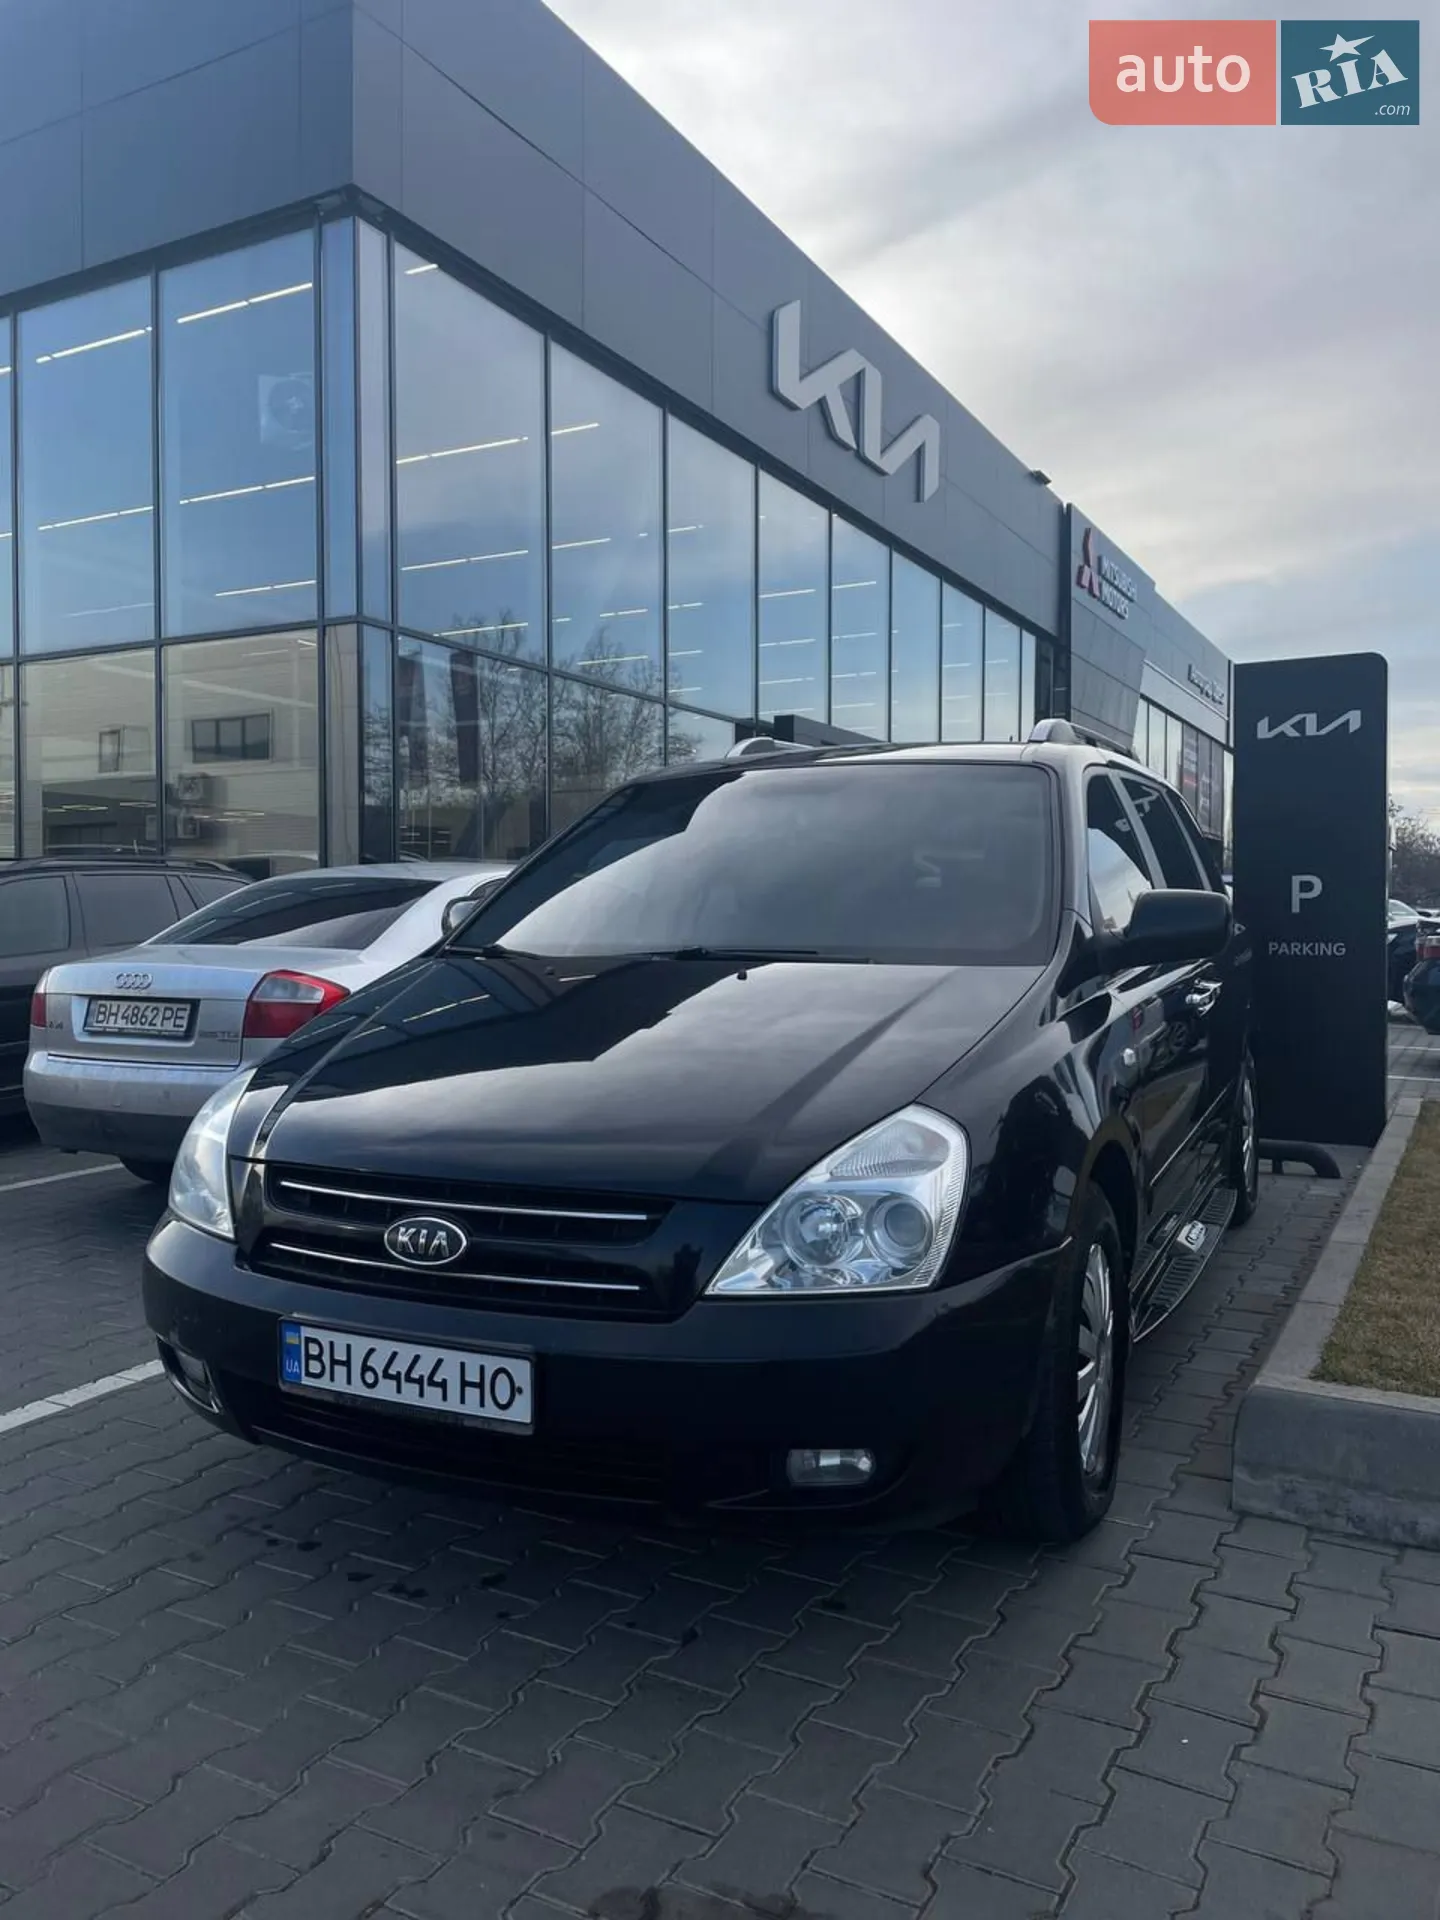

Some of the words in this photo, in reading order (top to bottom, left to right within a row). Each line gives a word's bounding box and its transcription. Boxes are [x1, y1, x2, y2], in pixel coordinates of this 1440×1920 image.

[1291, 875, 1323, 913] P
[1268, 942, 1346, 957] PARKING
[397, 1226, 449, 1257] KIA
[286, 1357, 299, 1374] UA
